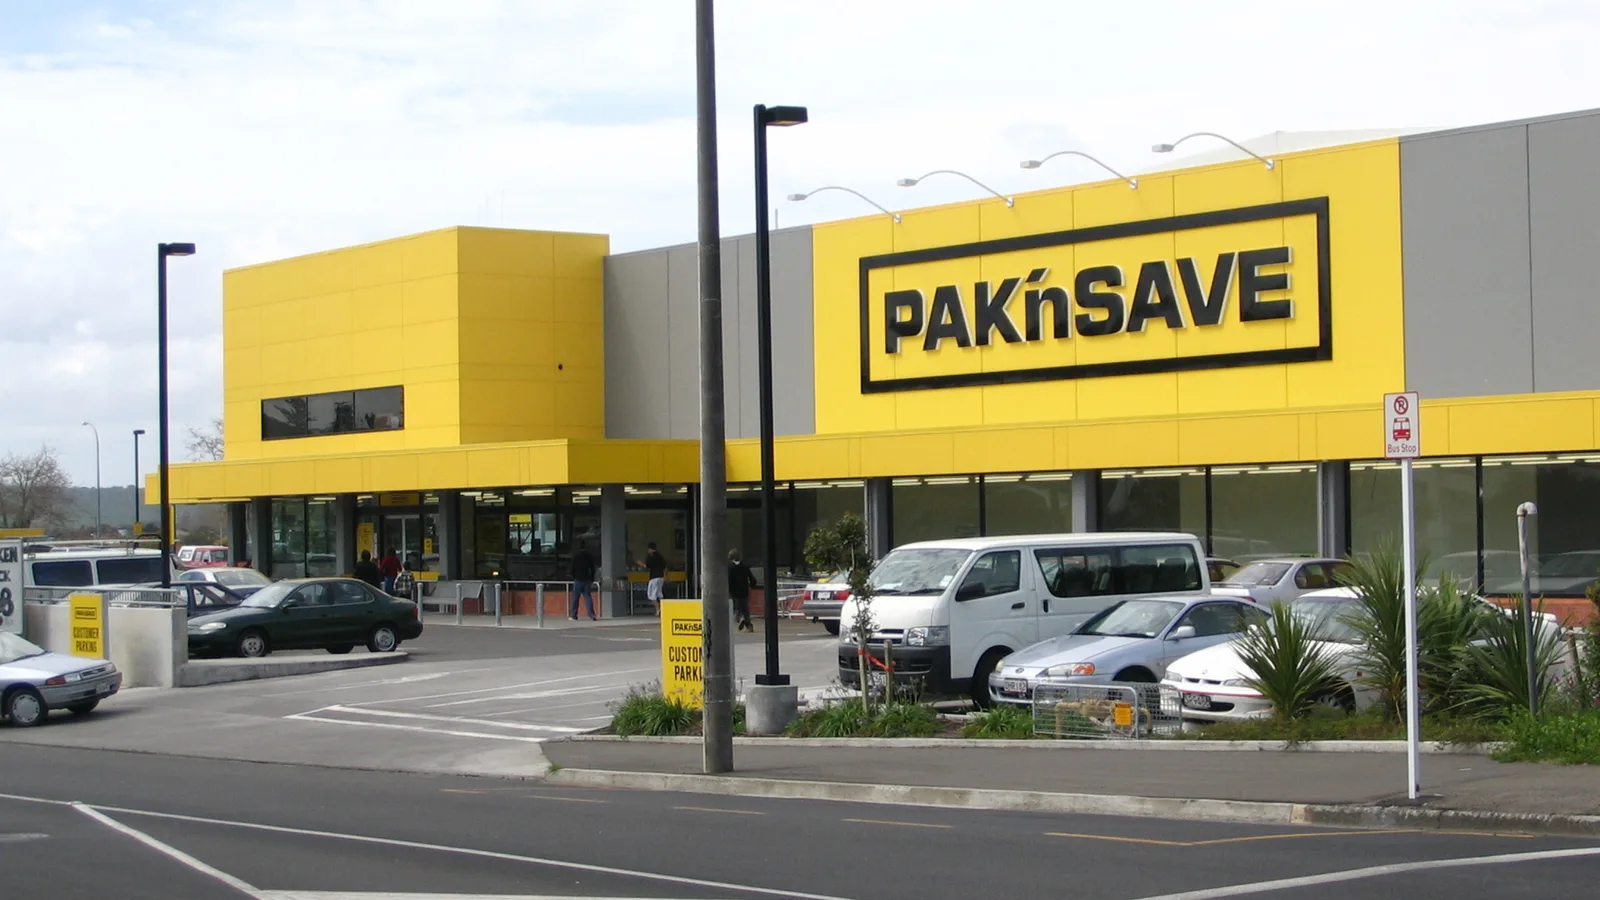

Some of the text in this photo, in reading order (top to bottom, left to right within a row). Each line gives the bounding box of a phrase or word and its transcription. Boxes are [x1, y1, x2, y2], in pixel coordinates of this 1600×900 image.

[1387, 443, 1417, 454] Bus Stop
[73, 626, 99, 639] CUSTOMER
[75, 640, 97, 652] PARKING
